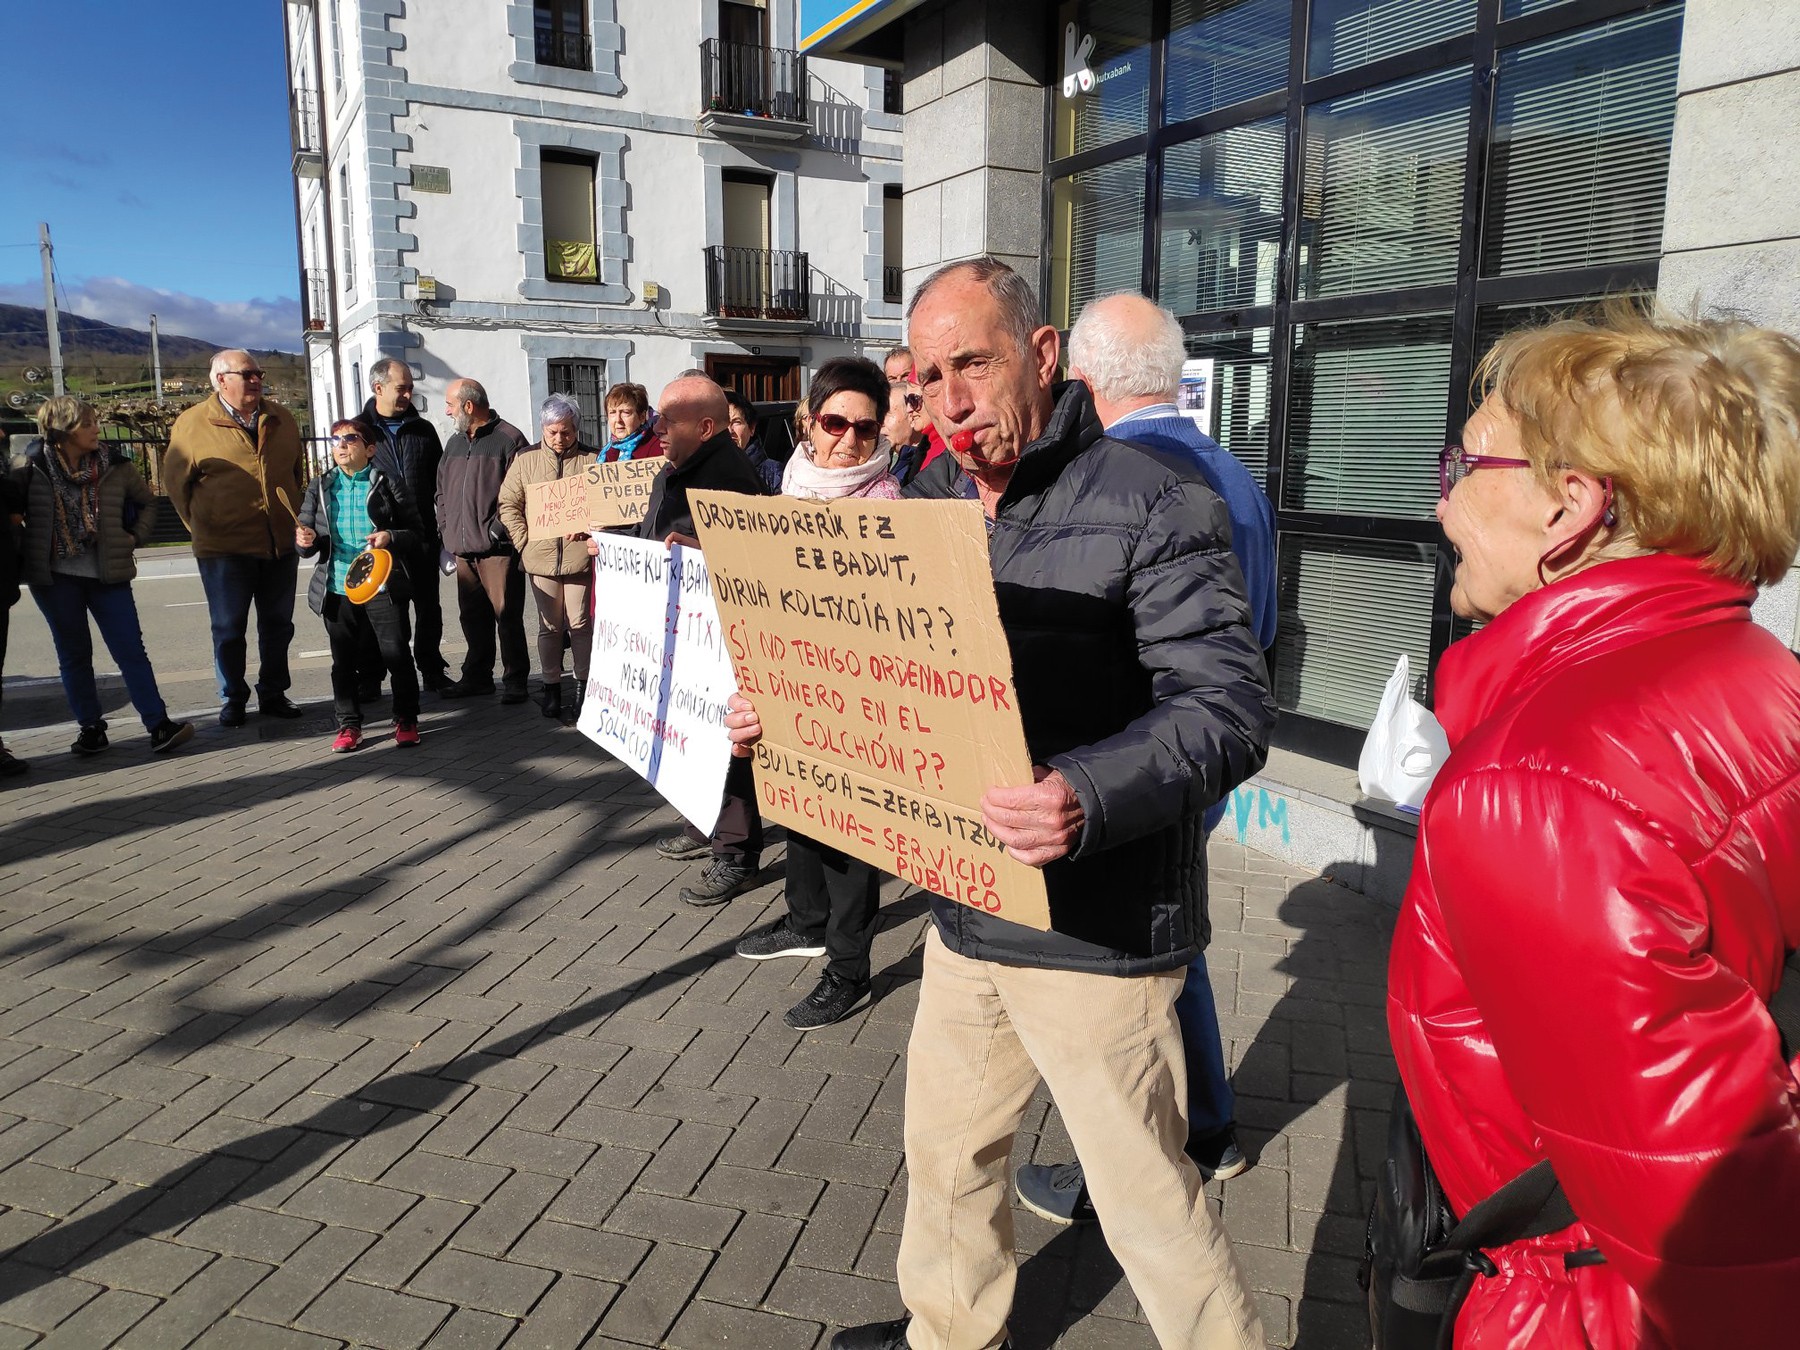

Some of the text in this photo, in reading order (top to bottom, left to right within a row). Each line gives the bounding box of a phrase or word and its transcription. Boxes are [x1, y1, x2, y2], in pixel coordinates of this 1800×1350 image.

[1096, 61, 1132, 84] kutxabank
[587, 464, 620, 485] SIN
[536, 476, 587, 502] TXUPA
[603, 483, 651, 499] PUEBL
[535, 506, 591, 528] MAS SERVI
[617, 501, 648, 519] VAC
[858, 514, 895, 539] EZ
[644, 550, 714, 597] KUTXABAN
[714, 567, 770, 608] DIRUA
[759, 629, 785, 661] NO
[791, 639, 861, 678] TENGO
[870, 655, 1010, 711] ORDENADOR
[767, 669, 845, 714] DINERO
[861, 696, 887, 727] EN
[899, 704, 932, 733] EL
